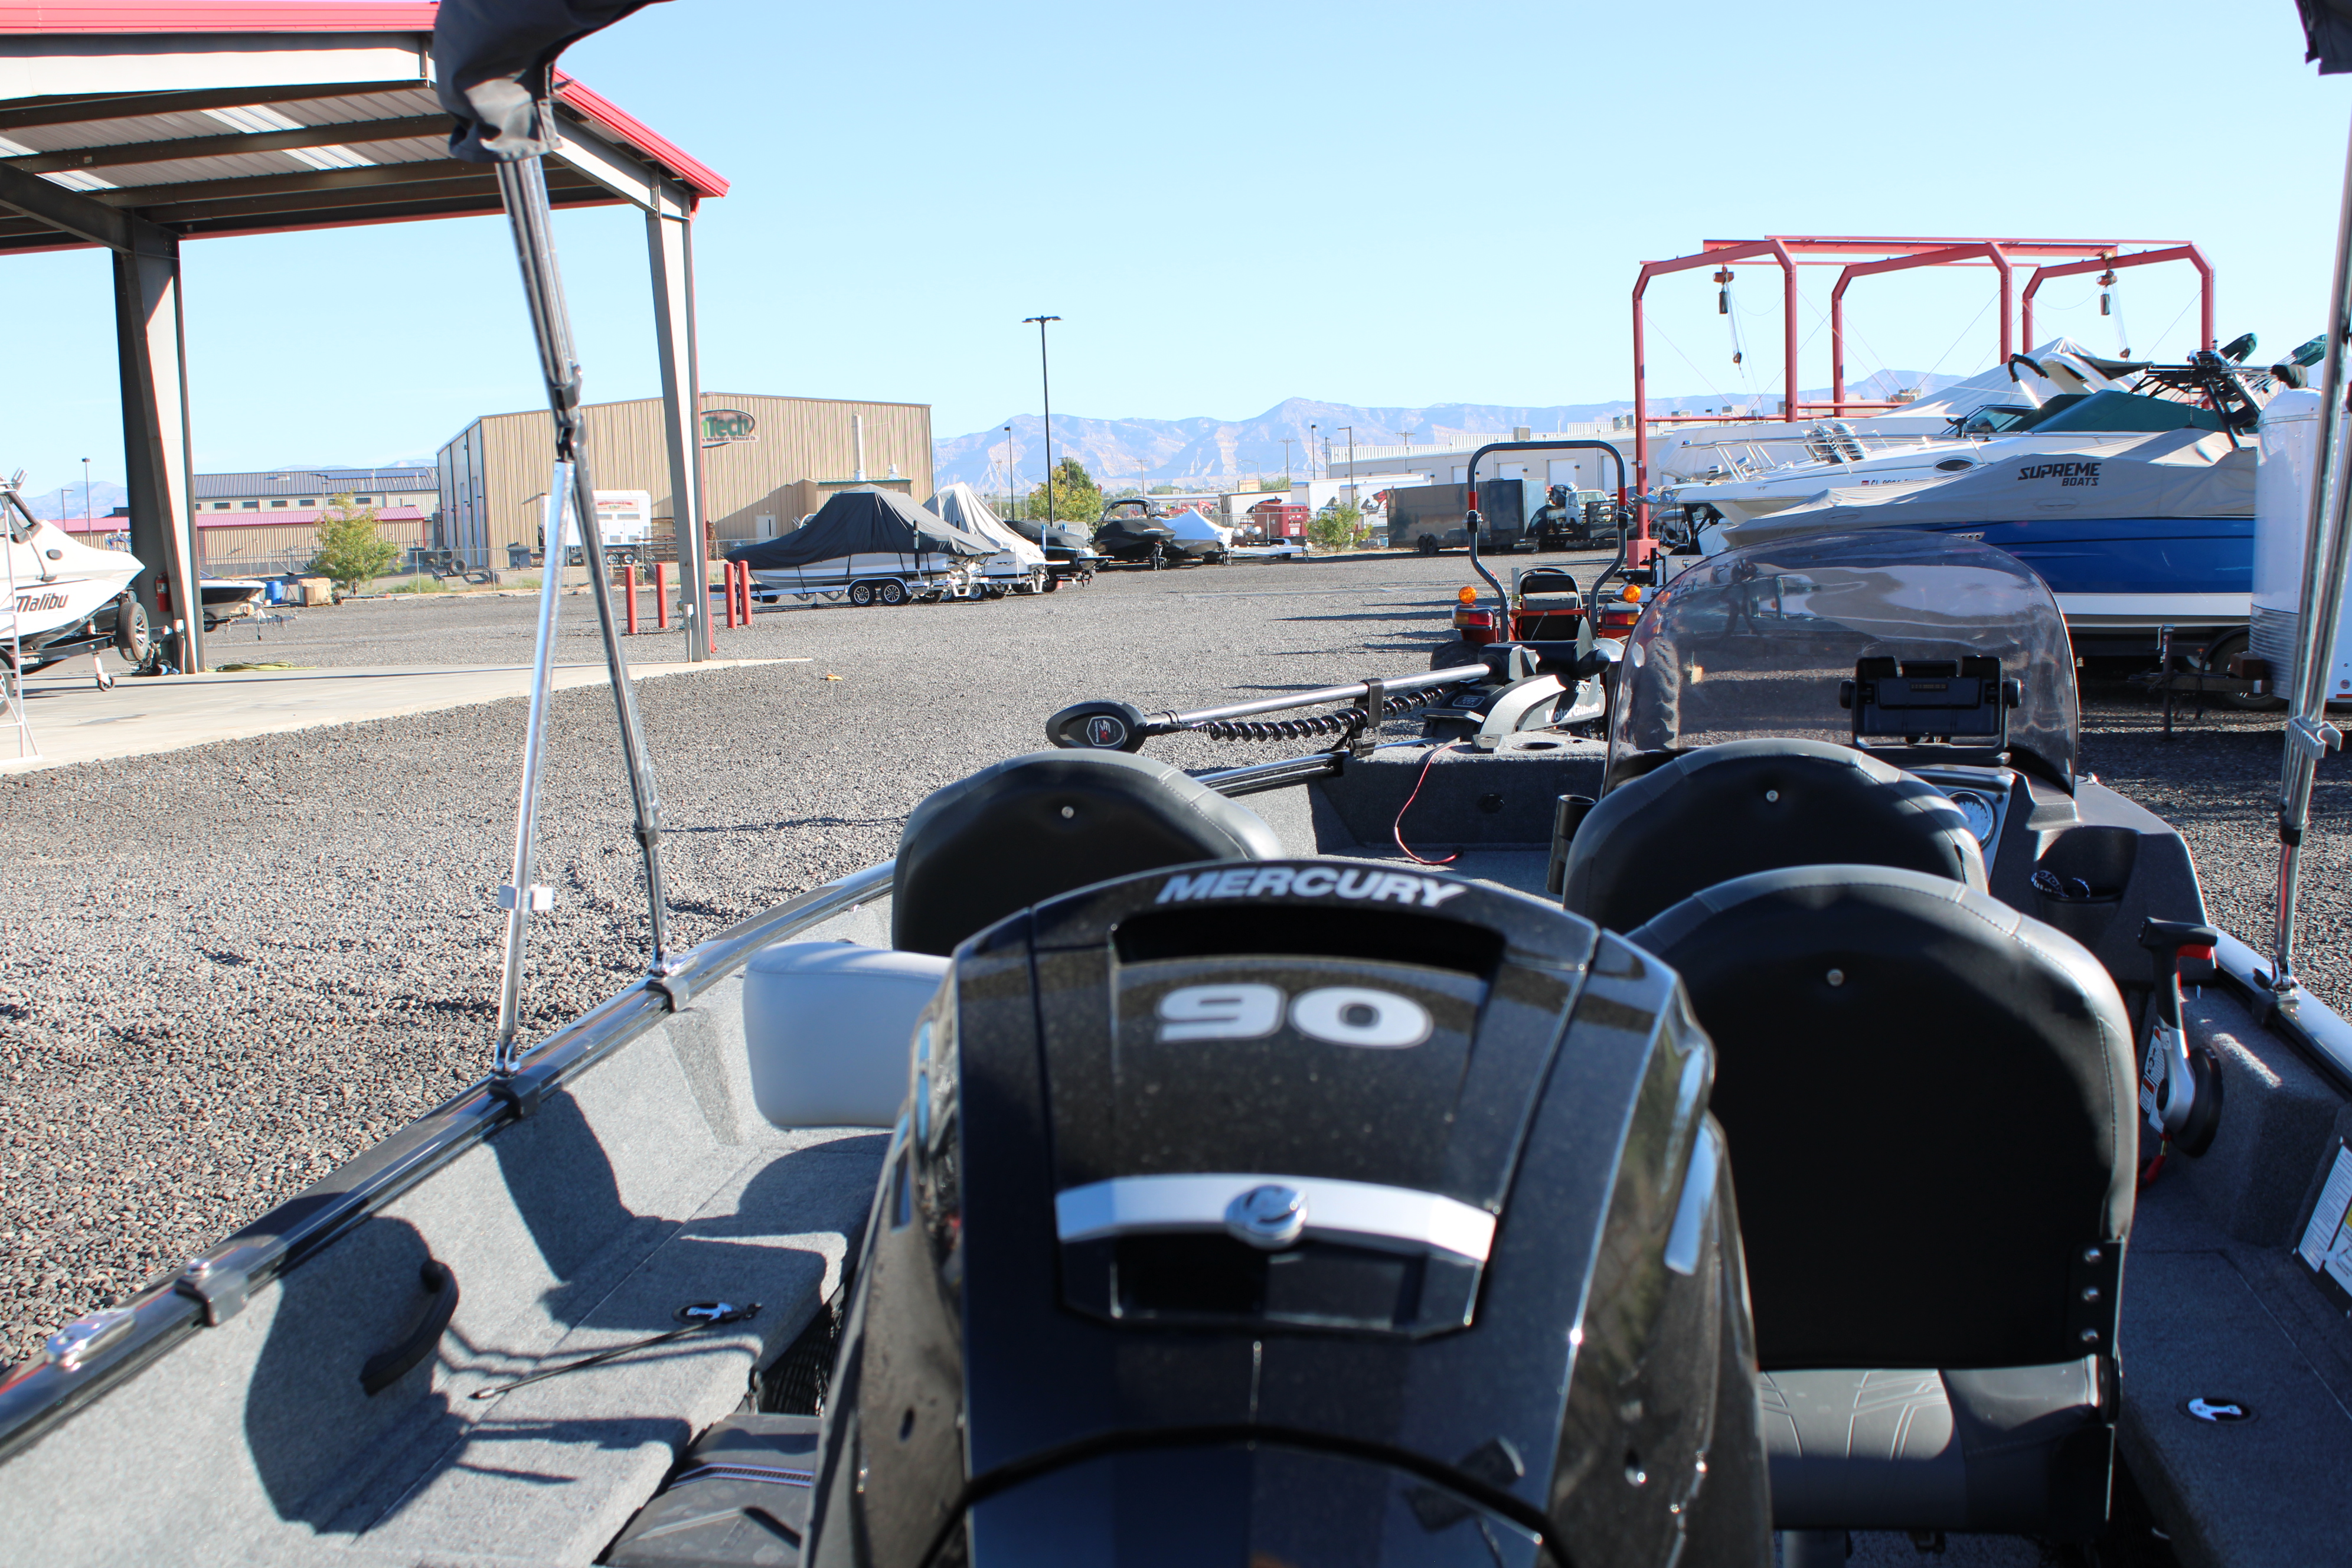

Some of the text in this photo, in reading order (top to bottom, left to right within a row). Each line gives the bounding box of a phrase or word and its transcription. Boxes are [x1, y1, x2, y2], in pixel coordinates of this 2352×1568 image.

[2017, 462, 2102, 481] SUPREME
[2062, 477, 2100, 486] BOATS
[1545, 703, 1600, 723] MotorGuide
[1155, 866, 1468, 908] MERCURY
[1154, 982, 1434, 1049] 90
